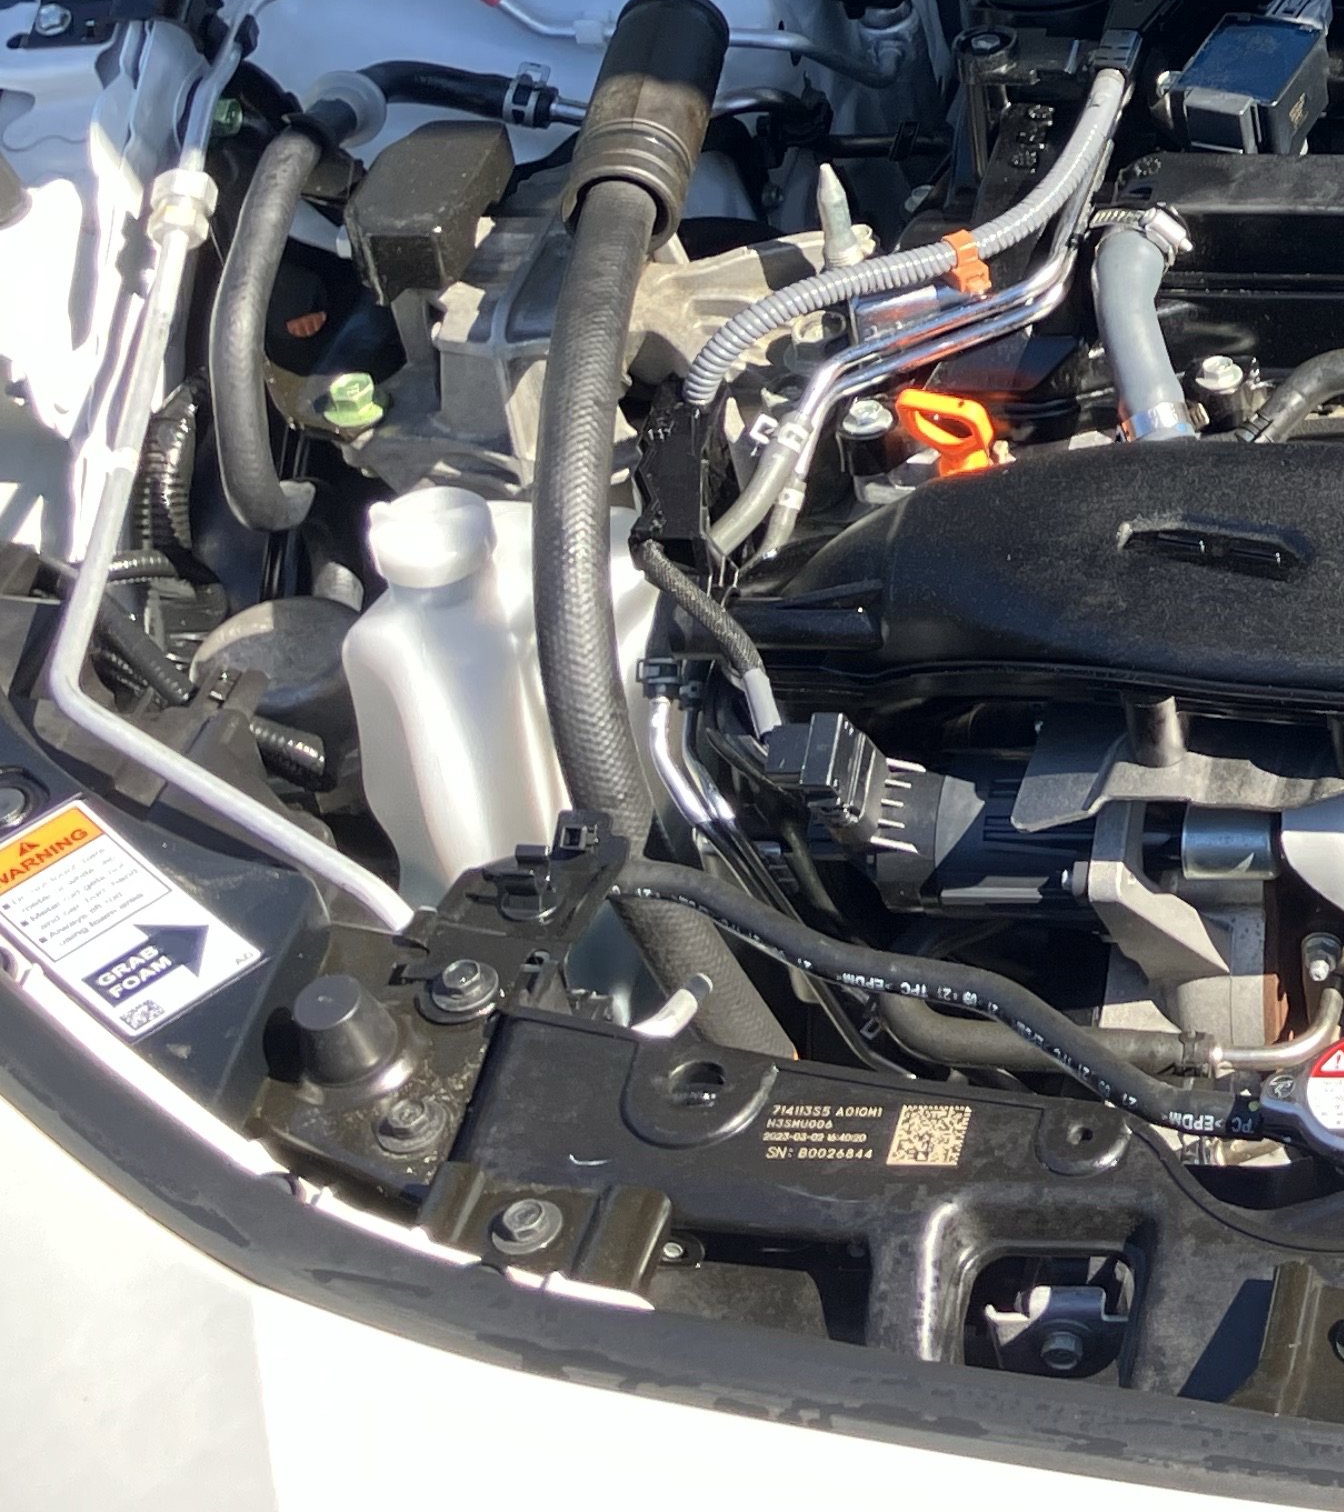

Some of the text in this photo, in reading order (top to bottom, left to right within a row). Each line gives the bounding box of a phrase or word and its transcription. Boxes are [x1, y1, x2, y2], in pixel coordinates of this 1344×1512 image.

[96, 945, 160, 986] GRAB
[107, 956, 172, 999] FOAM
[765, 1146, 873, 1159] SN: B0026844
